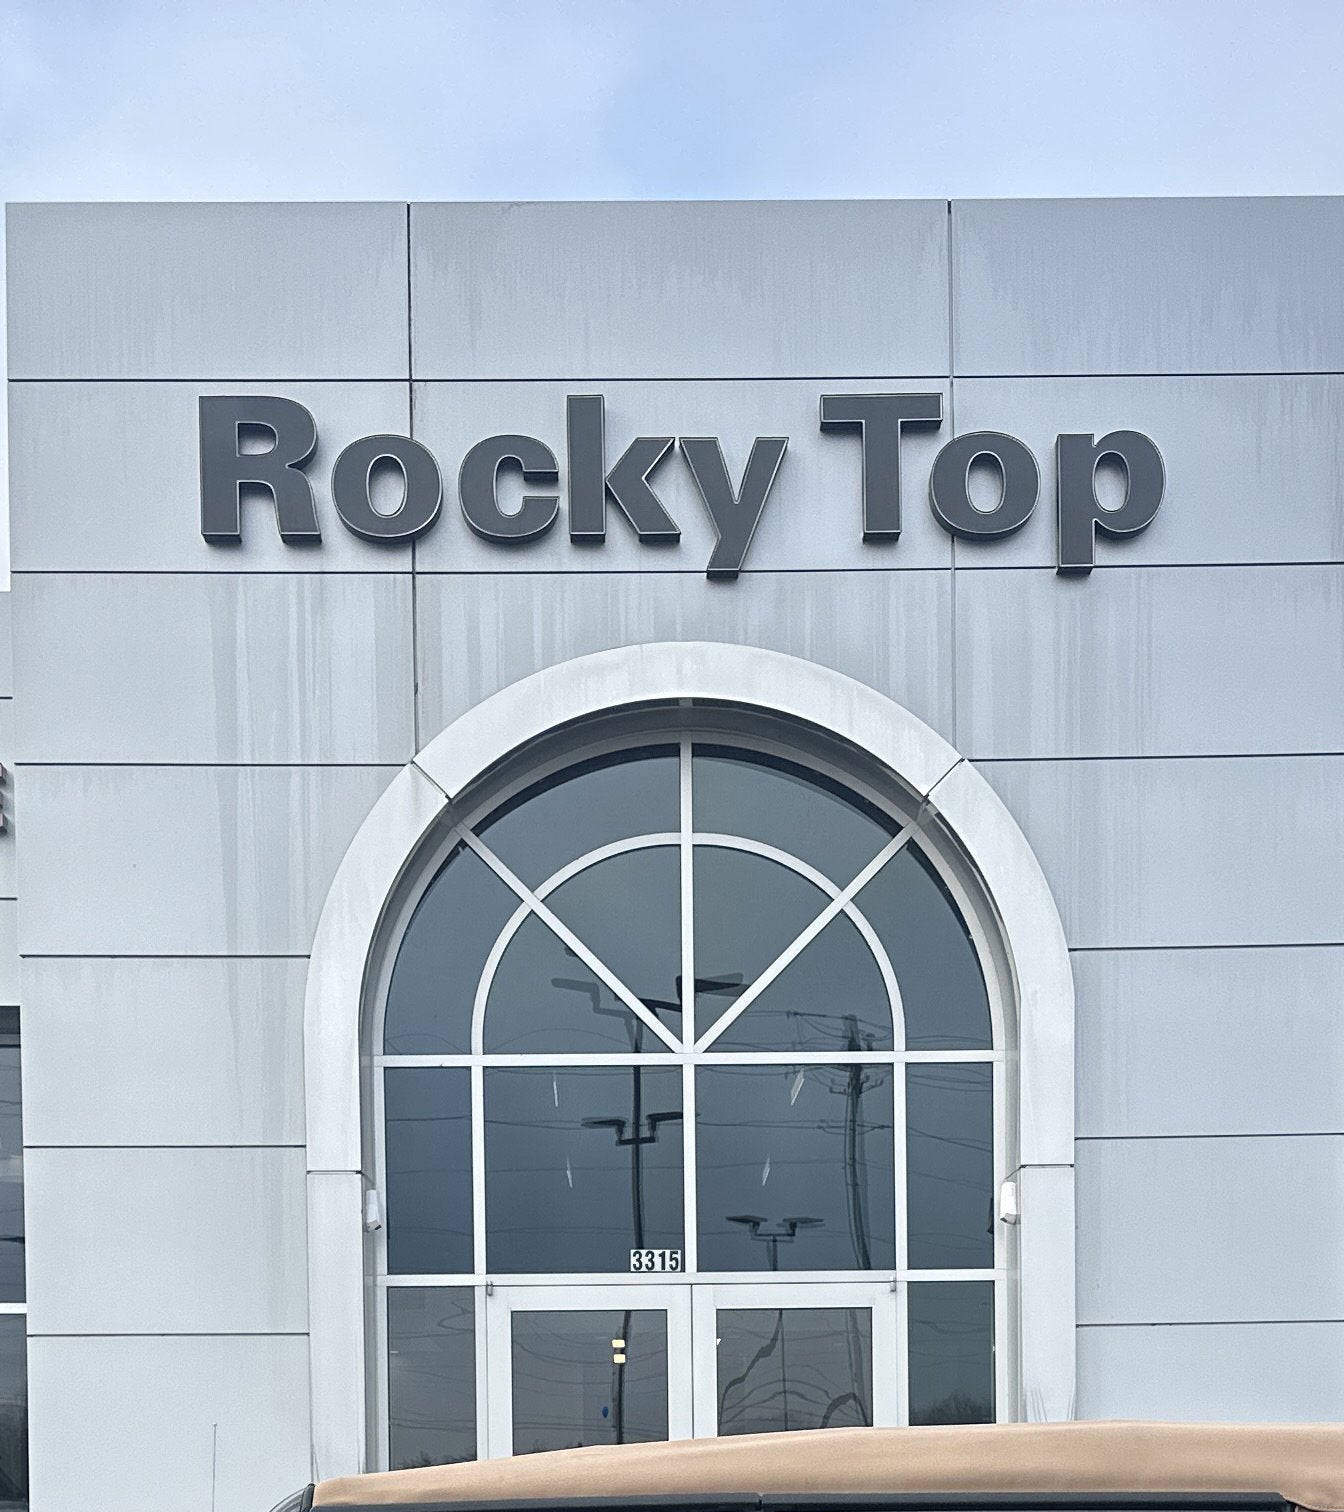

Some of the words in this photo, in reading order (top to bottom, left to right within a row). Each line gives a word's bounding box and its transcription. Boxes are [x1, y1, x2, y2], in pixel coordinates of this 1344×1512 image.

[198, 393, 790, 580] Rocky
[819, 391, 1167, 576] Top
[632, 1250, 680, 1271] 3315
